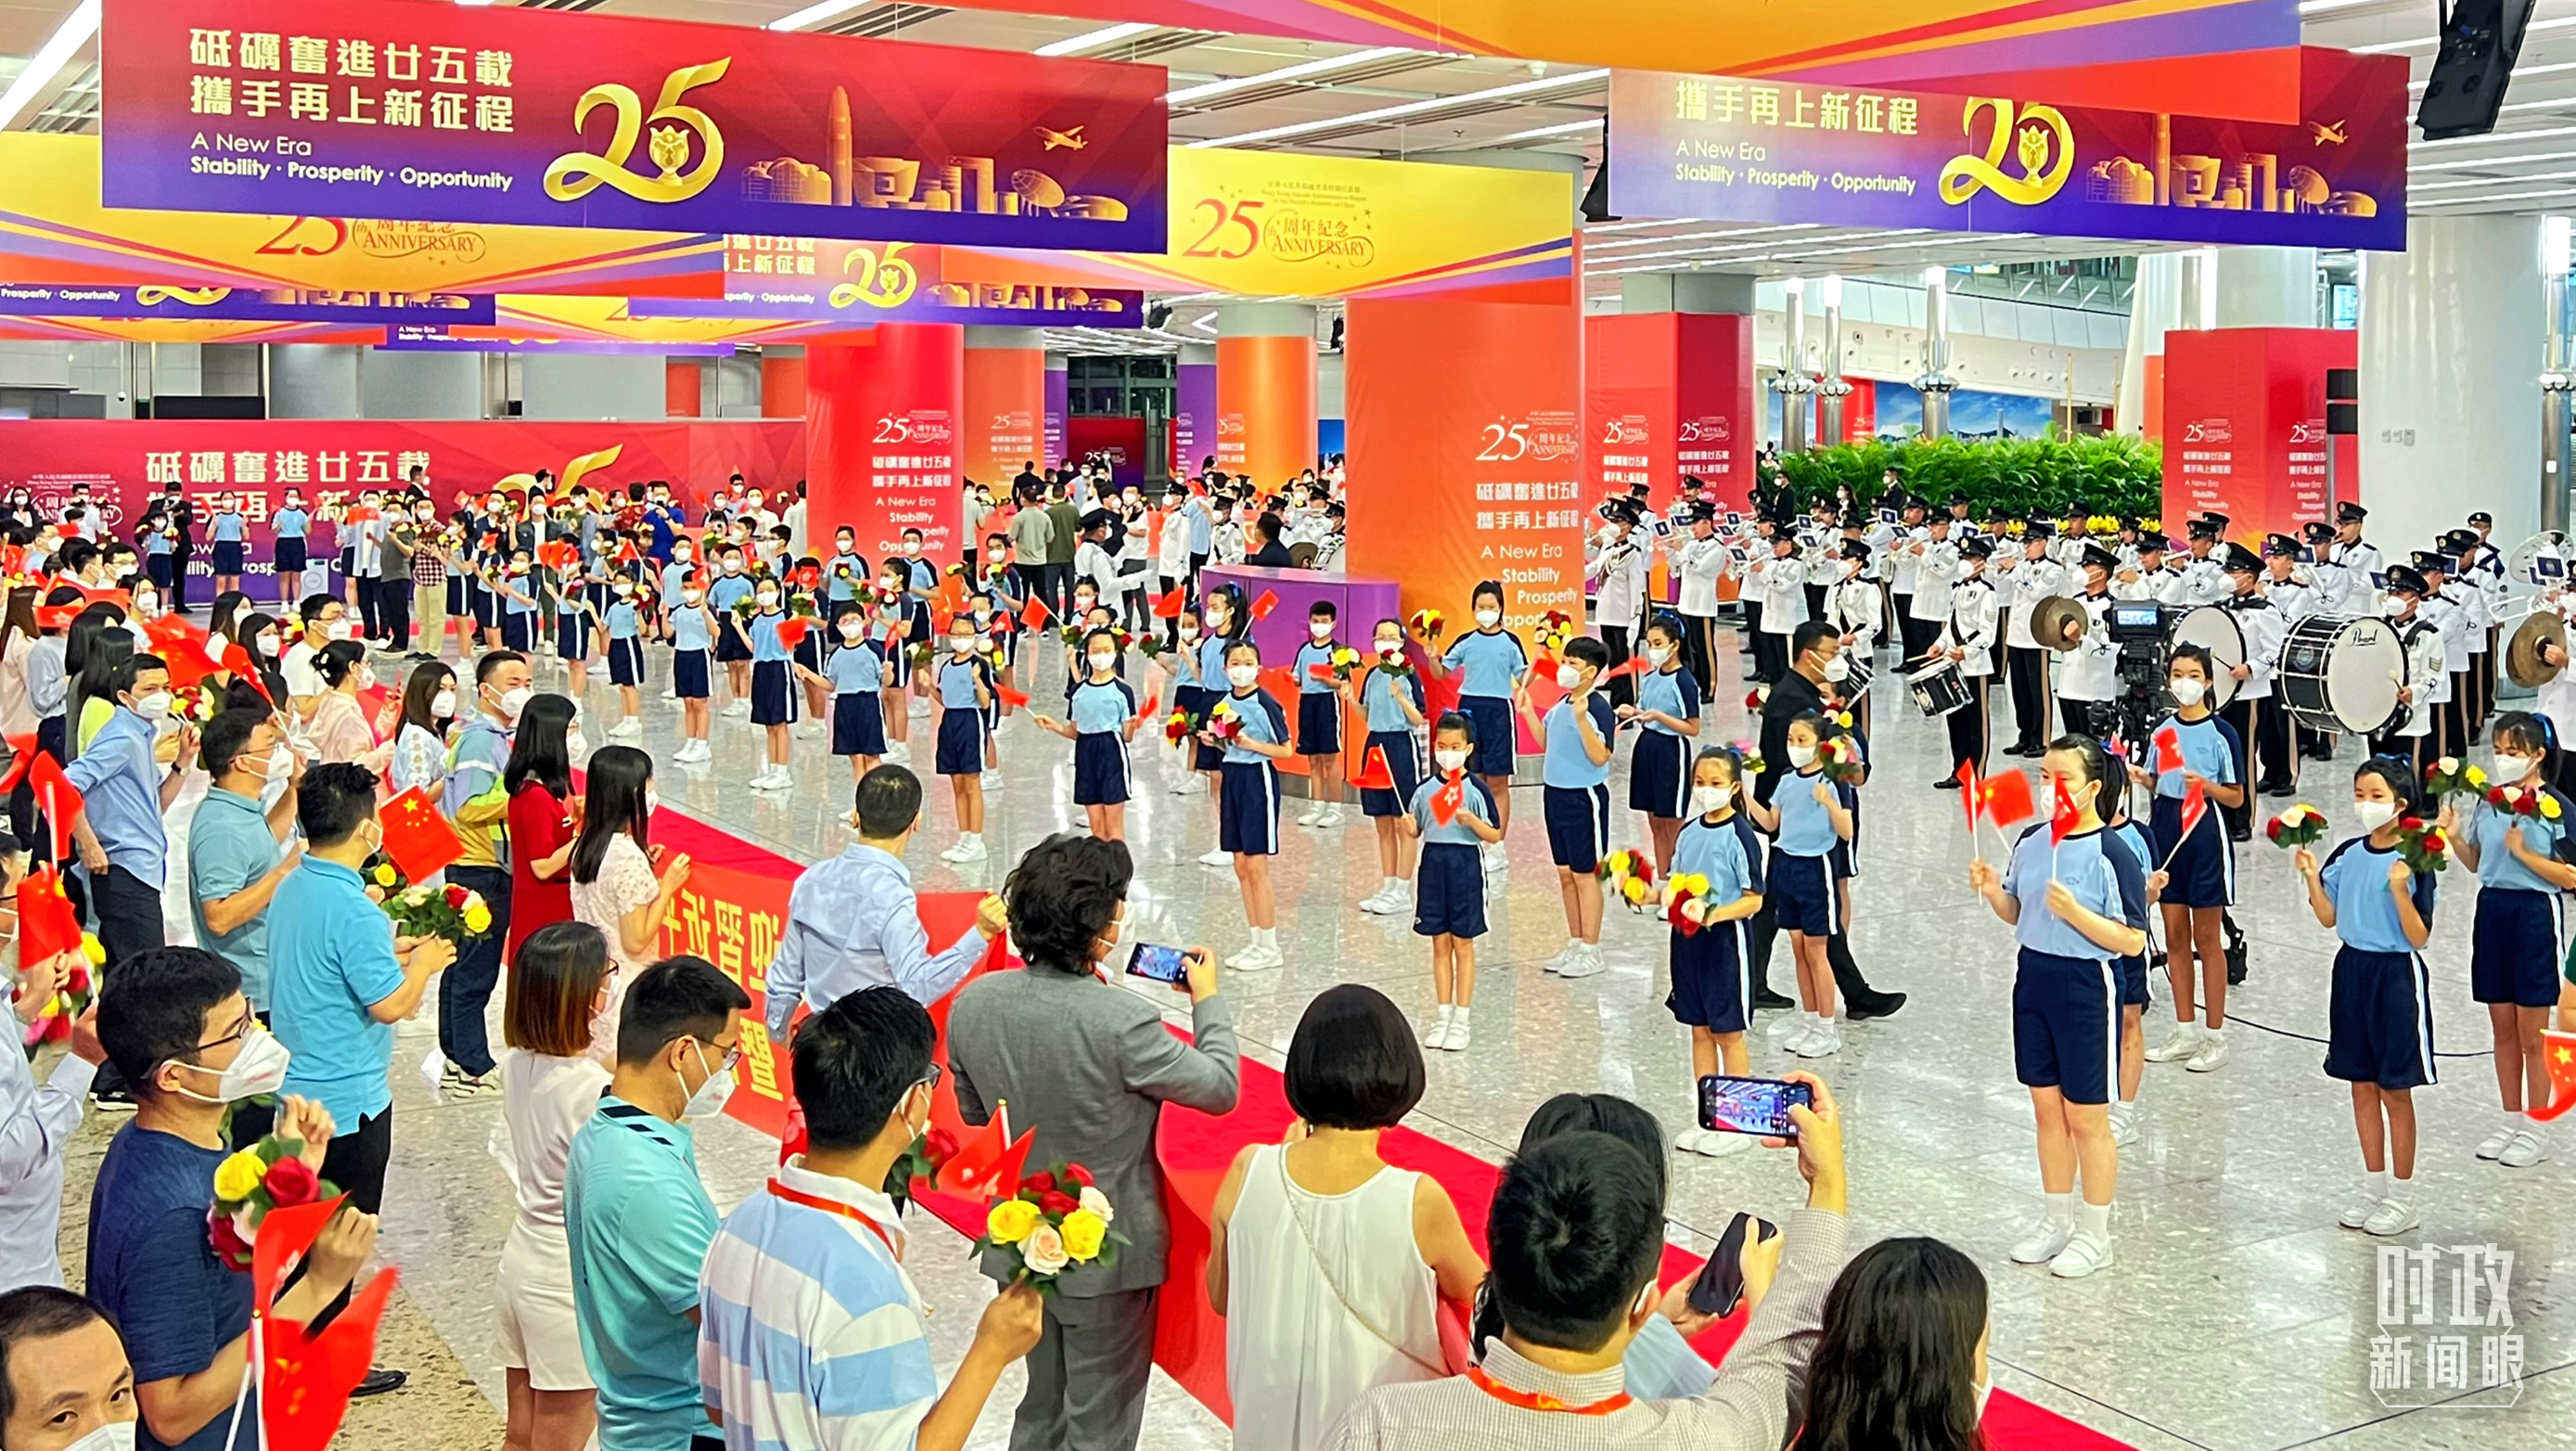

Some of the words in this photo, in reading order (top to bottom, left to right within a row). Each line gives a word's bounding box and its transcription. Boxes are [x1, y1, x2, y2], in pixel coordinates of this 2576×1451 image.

[189, 28, 513, 87] 砥礪奮進廿五載
[190, 75, 514, 133] 攜手再上新征程
[1675, 80, 1918, 135] 攜手再上新征程
[544, 56, 731, 202] 25
[190, 132, 209, 151] A
[216, 133, 270, 153] New
[276, 135, 312, 156] Era
[1675, 139, 1690, 158] A
[1695, 139, 1733, 160] New
[1739, 141, 1766, 161] Era
[190, 155, 271, 180] Stability
[288, 161, 384, 186] Prosperity
[400, 167, 513, 192] Opportunity
[1675, 163, 1736, 186] Stability
[1748, 168, 1819, 191] Prosperity
[1831, 172, 1916, 196] Opportunity
[1183, 198, 1264, 259] 25
[1284, 218, 1349, 238] 周年紀念
[724, 253, 815, 275] 上新征程
[829, 241, 917, 309] 25
[59, 289, 121, 302] Opportunity
[761, 292, 815, 304] Opportunity
[872, 418, 911, 443] 25
[991, 416, 1011, 430] 25
[1603, 422, 1622, 443] 25
[1678, 422, 1700, 442] 25
[2184, 425, 2205, 443] 25
[2289, 425, 2309, 443] 25
[1475, 424, 1530, 461] 25
[146, 451, 430, 484] 砥礪奮進廿五載
[875, 496, 885, 507] A
[888, 496, 916, 507] New
[919, 495, 936, 507] Era
[890, 511, 935, 525] Stability
[1480, 545, 1494, 559] A
[1500, 545, 1538, 559] New
[1542, 543, 1563, 559] Era
[1502, 567, 1560, 585] Stability
[1518, 587, 1578, 607] Prosperity
